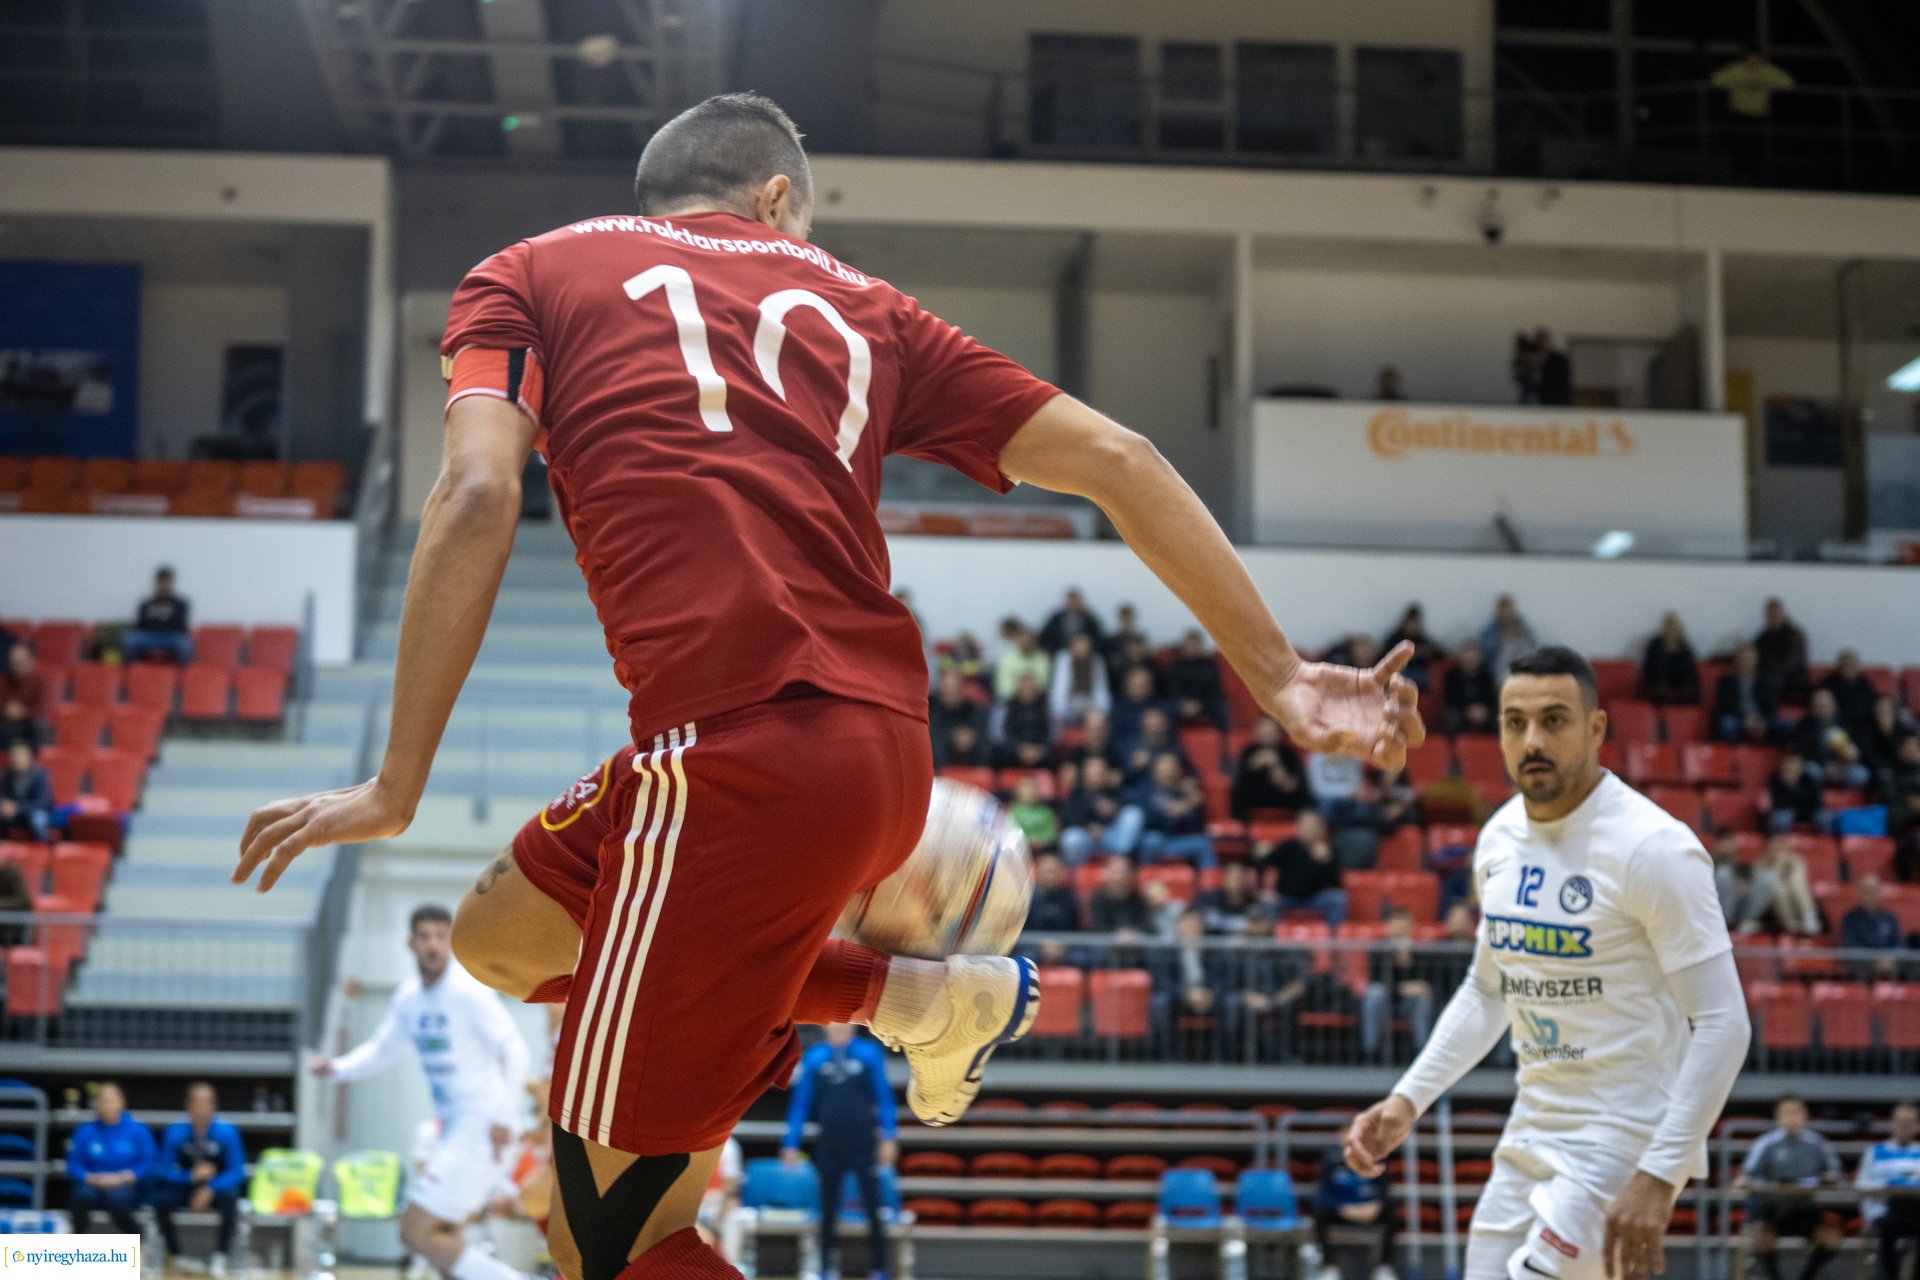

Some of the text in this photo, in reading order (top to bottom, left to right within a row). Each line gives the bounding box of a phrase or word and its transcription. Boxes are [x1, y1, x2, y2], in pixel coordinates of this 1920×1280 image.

[622, 264, 873, 474] 10
[1366, 407, 1599, 463] Continental
[1515, 864, 1546, 908] 12
